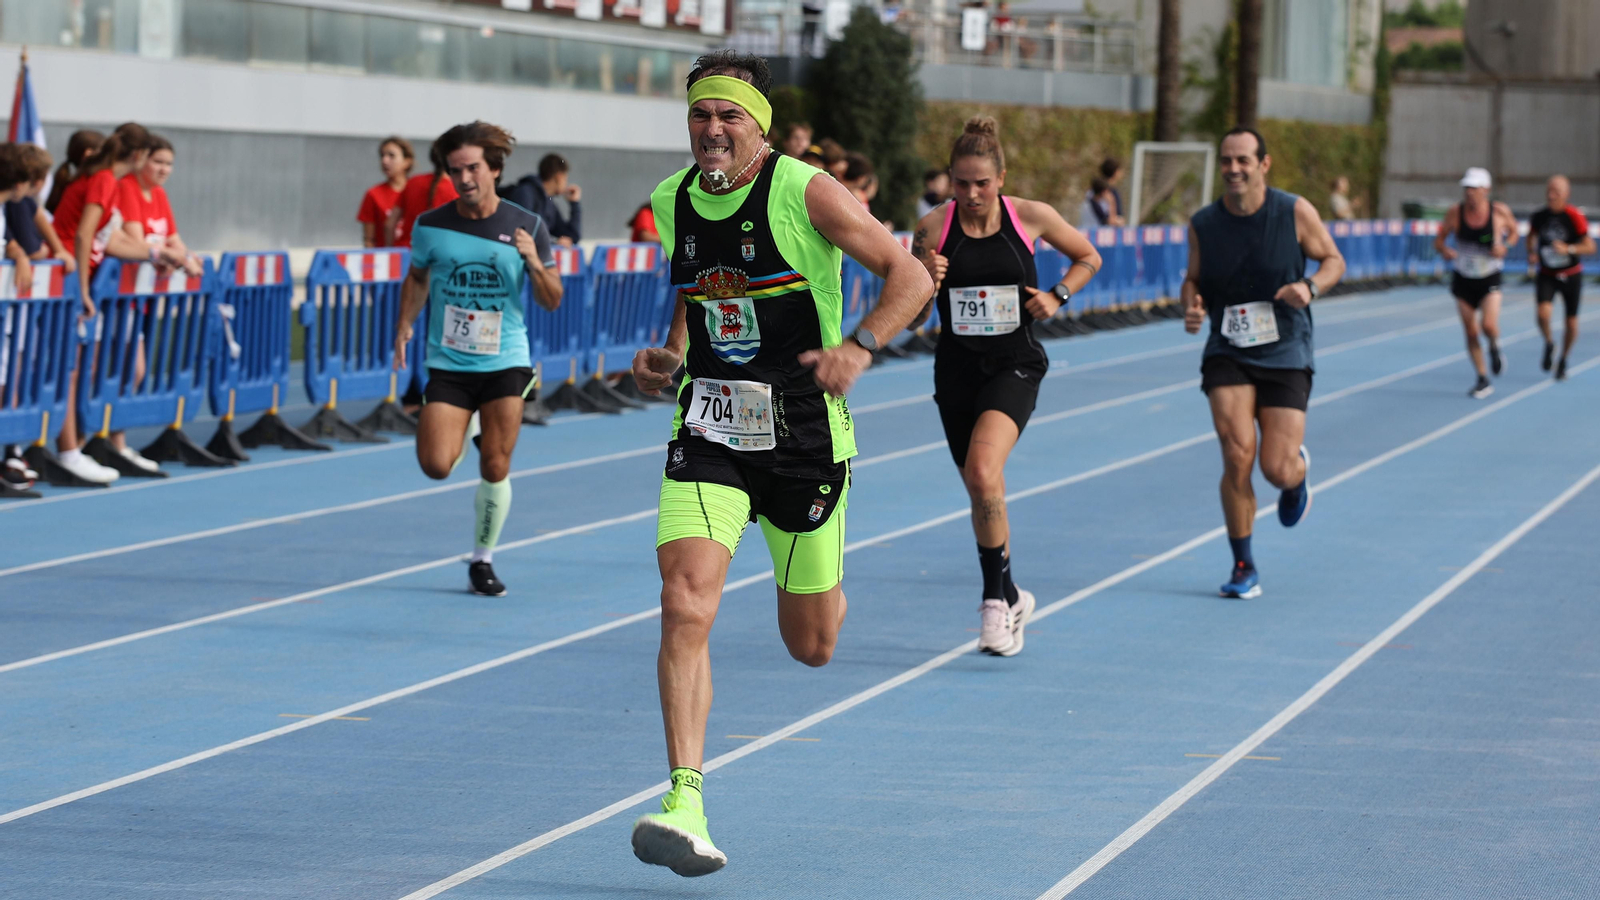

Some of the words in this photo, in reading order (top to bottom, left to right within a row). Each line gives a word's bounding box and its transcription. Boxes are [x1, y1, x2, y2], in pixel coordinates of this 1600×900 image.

[957, 300, 986, 317] 791
[453, 320, 470, 337] 75
[699, 396, 734, 424] 704
